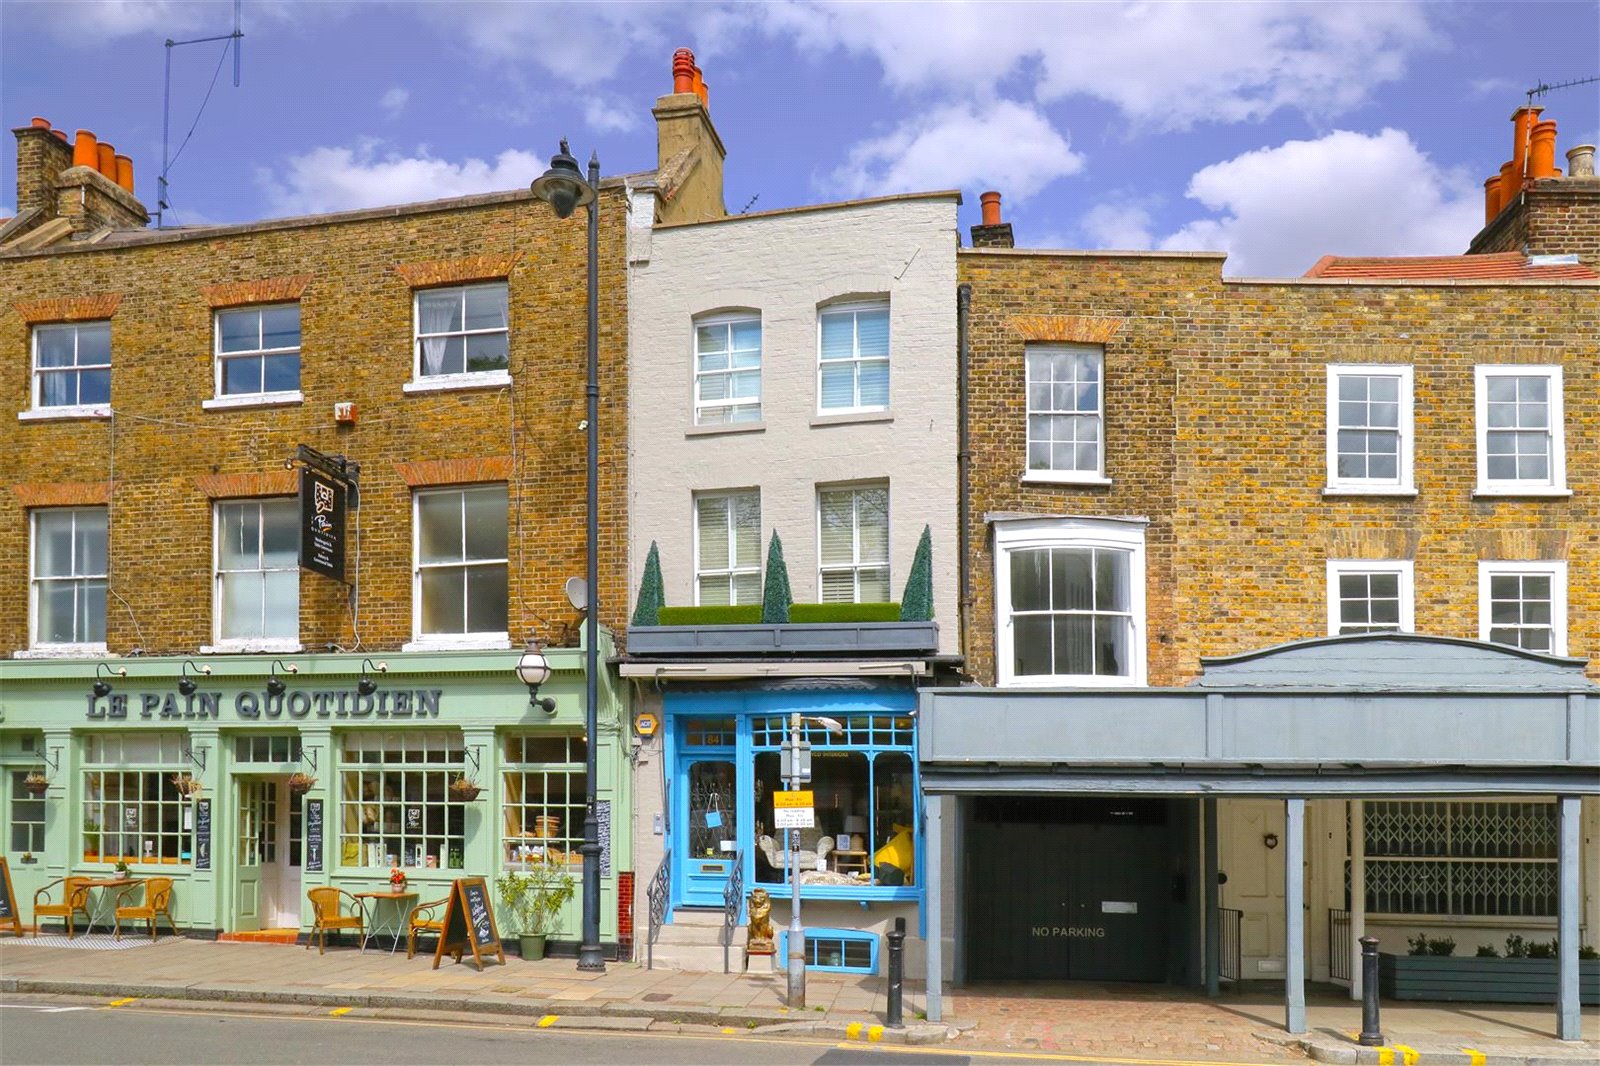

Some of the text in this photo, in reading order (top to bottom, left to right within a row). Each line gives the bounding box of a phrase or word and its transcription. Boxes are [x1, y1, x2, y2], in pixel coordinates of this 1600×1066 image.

[314, 514, 333, 529] Pain
[86, 691, 442, 718] LE PAIN QUOTIDIEN
[1032, 927, 1105, 938] NO PARKING
